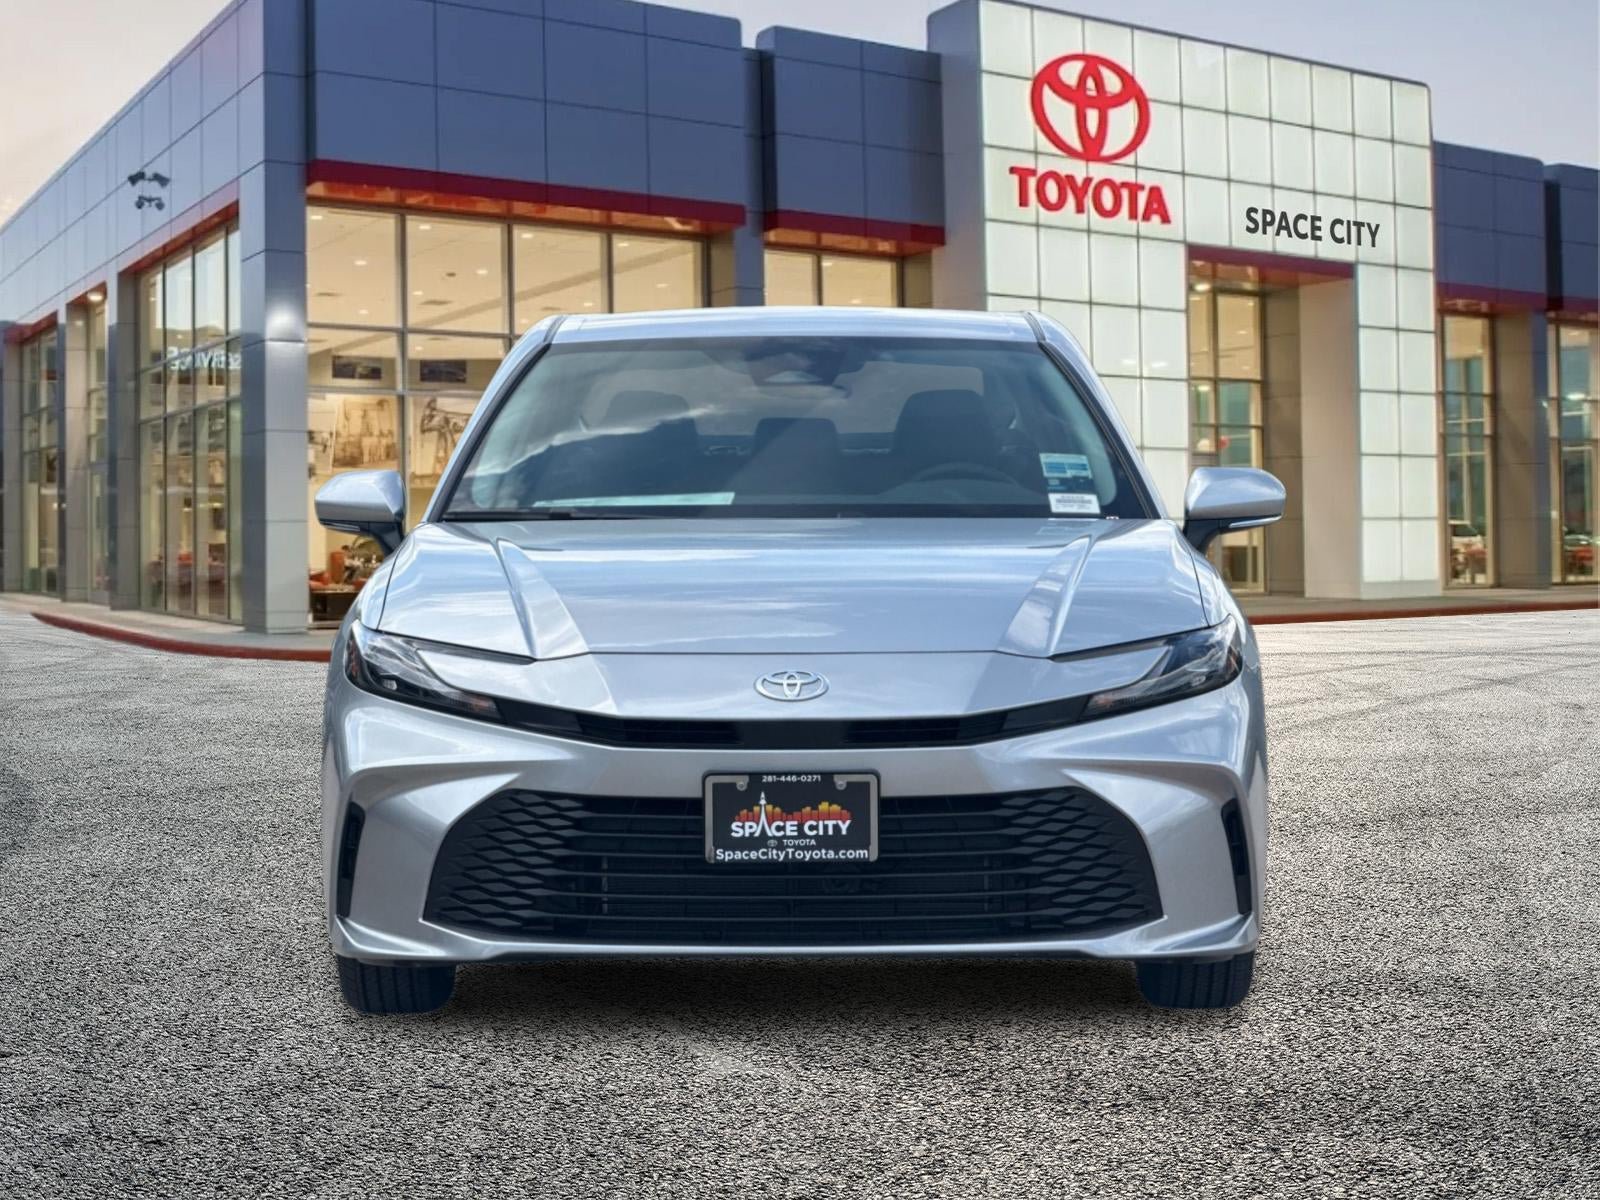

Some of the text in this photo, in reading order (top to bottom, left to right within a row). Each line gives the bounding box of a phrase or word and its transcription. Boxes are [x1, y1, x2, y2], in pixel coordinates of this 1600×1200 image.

[1009, 166, 1172, 224] TOYOTA
[1245, 206, 1381, 248] SPACE CITY
[731, 820, 851, 838] SPACE CITY
[716, 848, 868, 862] SpaceCityToyota.com
